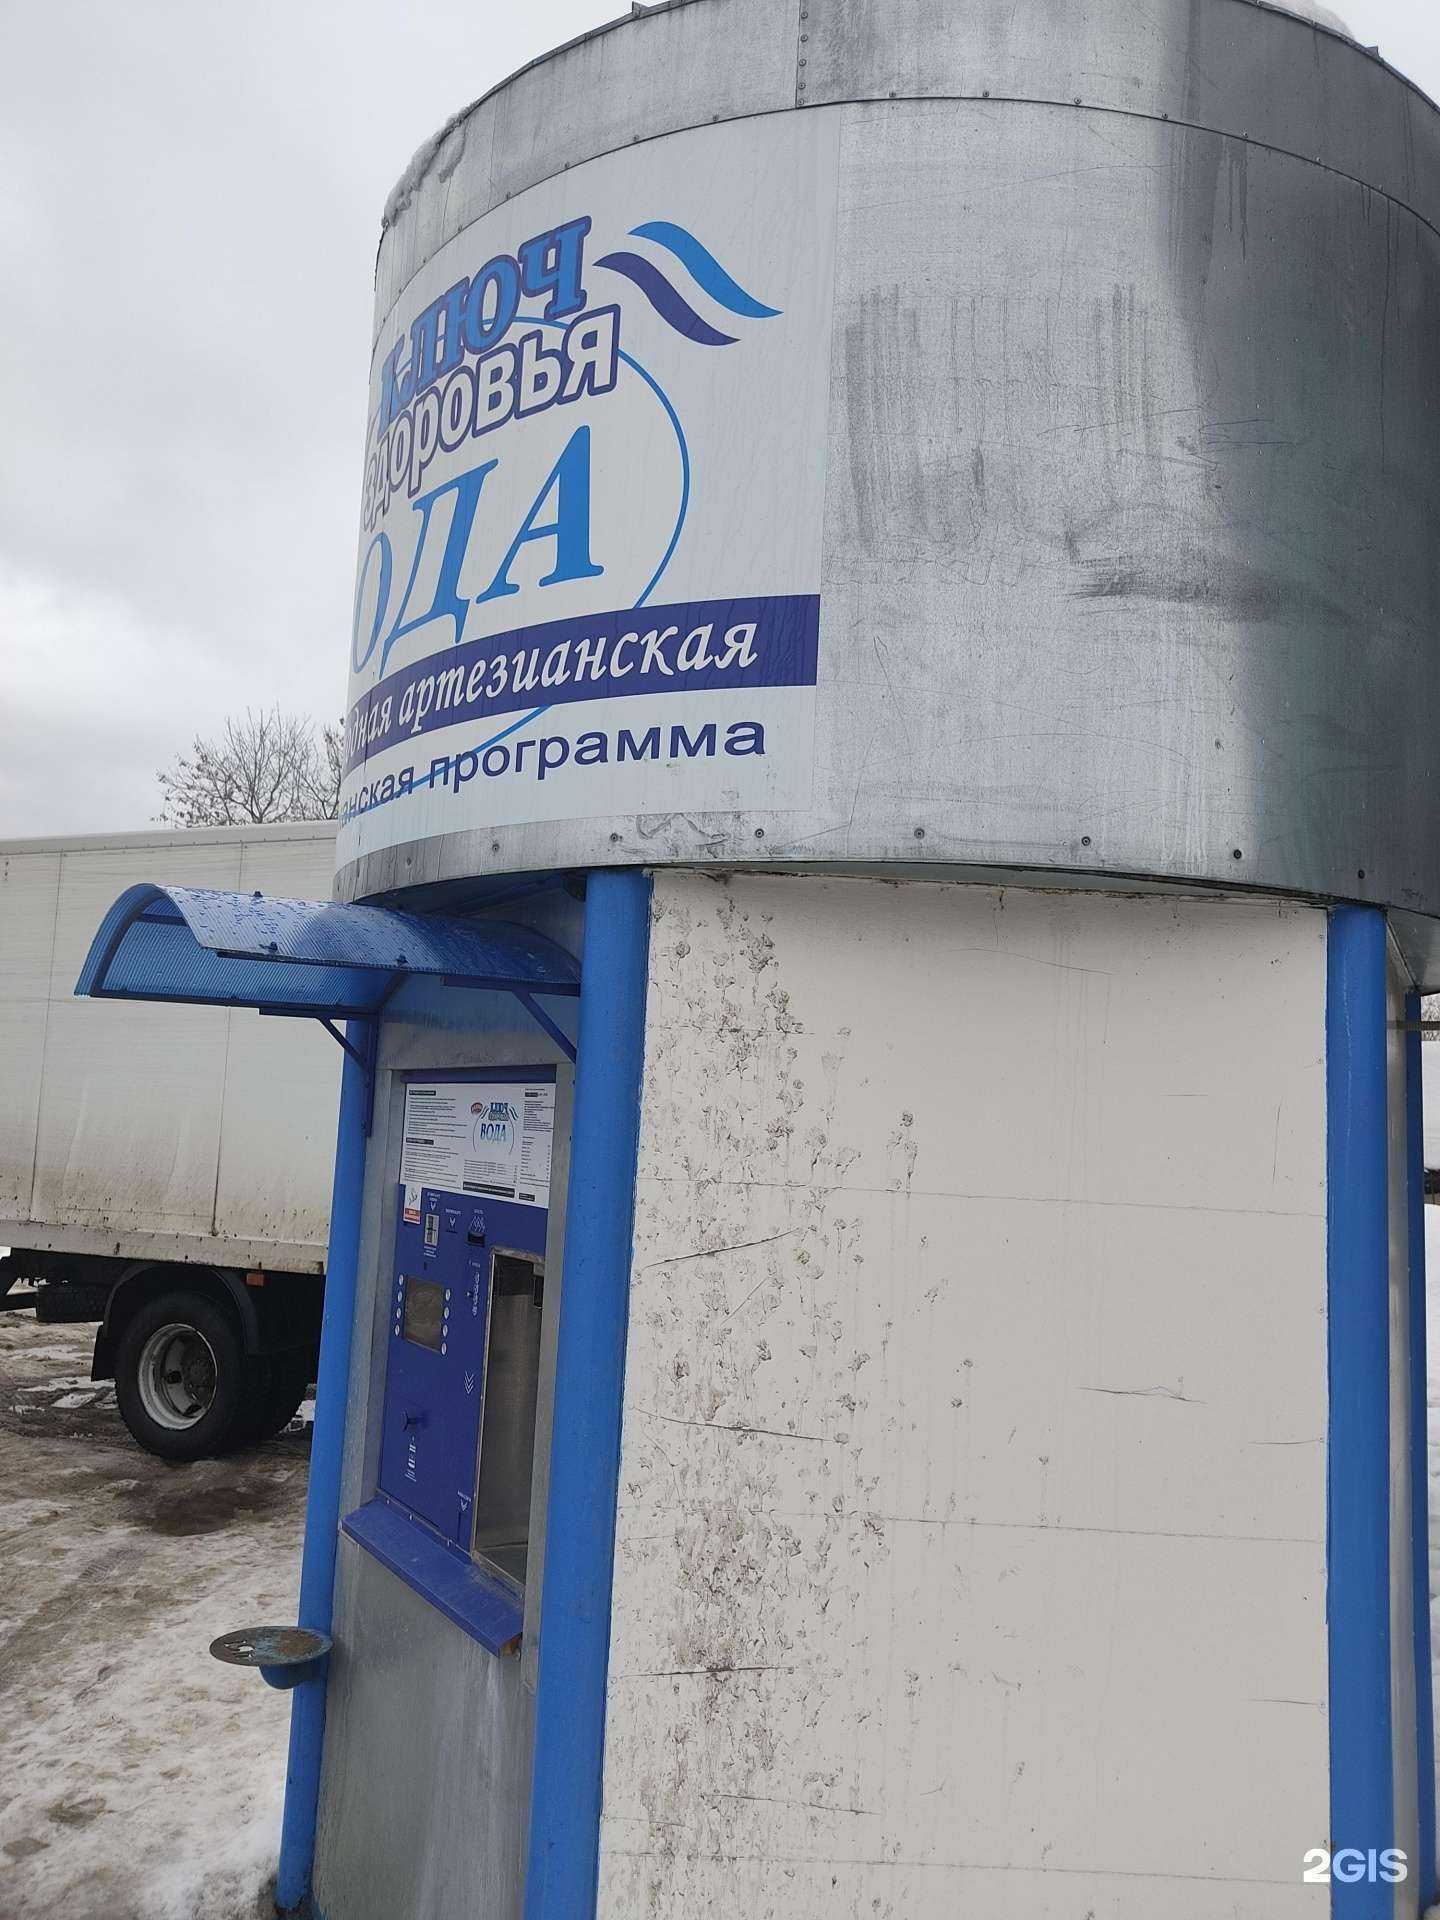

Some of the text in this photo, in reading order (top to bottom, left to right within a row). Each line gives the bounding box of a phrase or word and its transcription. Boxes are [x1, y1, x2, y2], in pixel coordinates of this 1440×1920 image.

[351, 424, 604, 680] ОДА
[398, 622, 760, 734] артезианская
[429, 721, 766, 793] программа
